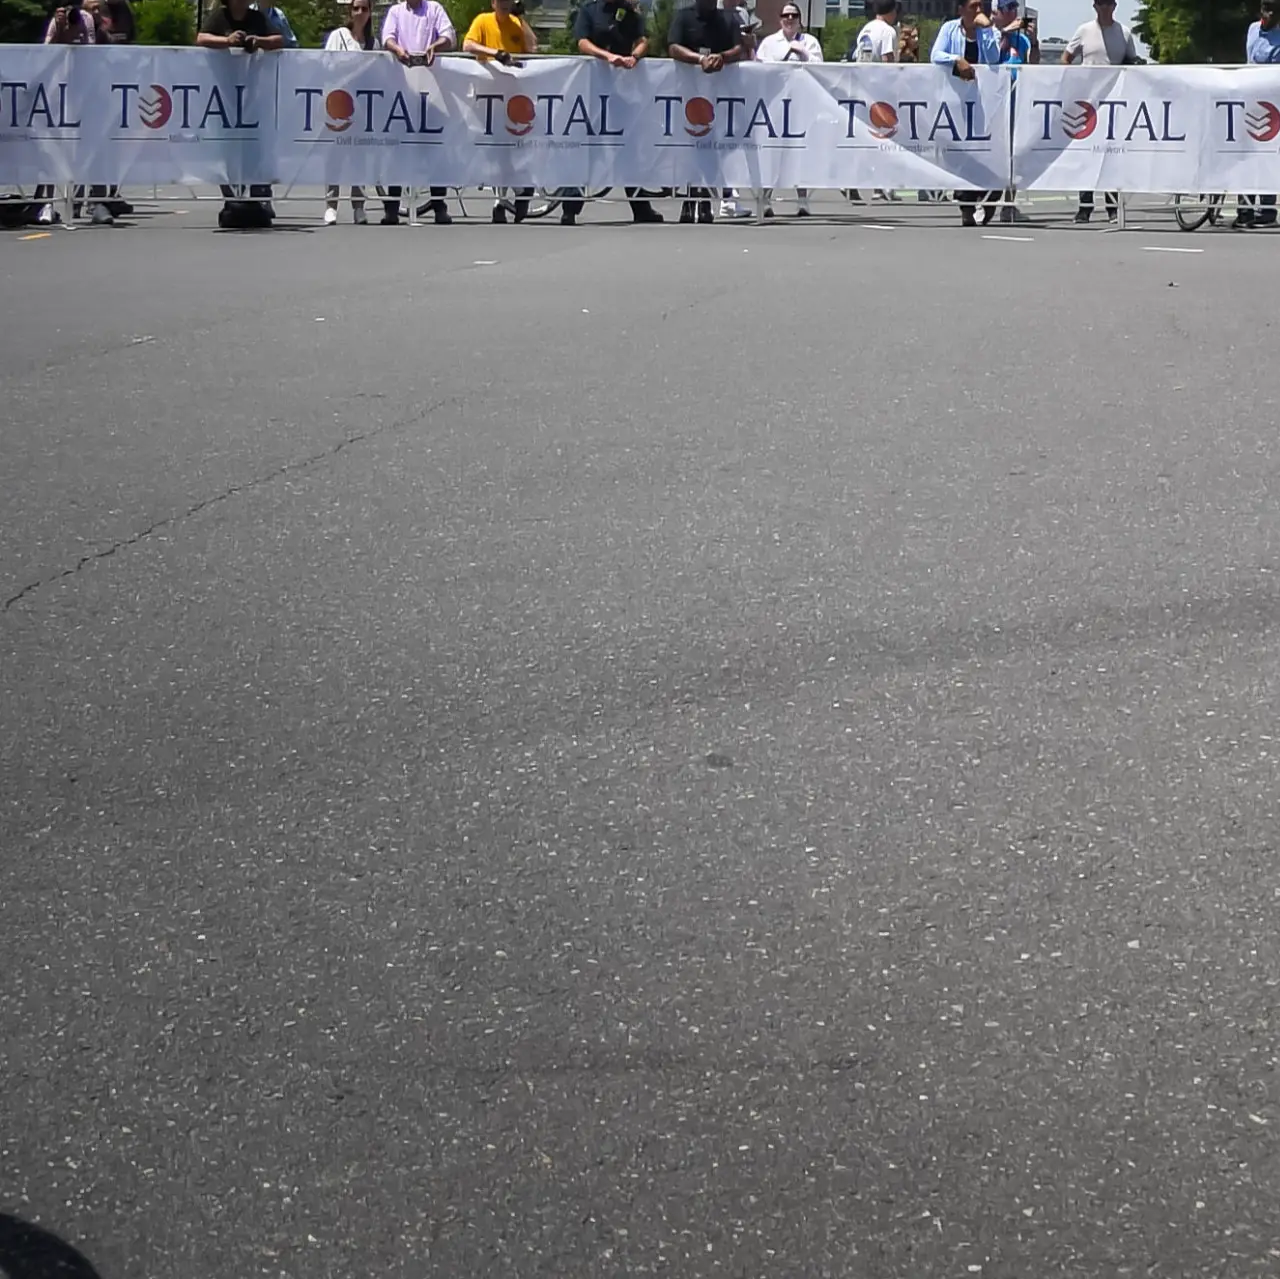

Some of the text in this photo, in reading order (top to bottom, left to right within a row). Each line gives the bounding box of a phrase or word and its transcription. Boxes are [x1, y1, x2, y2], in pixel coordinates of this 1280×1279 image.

[111, 84, 259, 129] TOTAL
[295, 88, 443, 134] TOTAL
[475, 94, 624, 136] TOTAL
[655, 95, 807, 138] TOTAL
[838, 99, 992, 141] TOTAL
[1032, 100, 1186, 141] TOTAL
